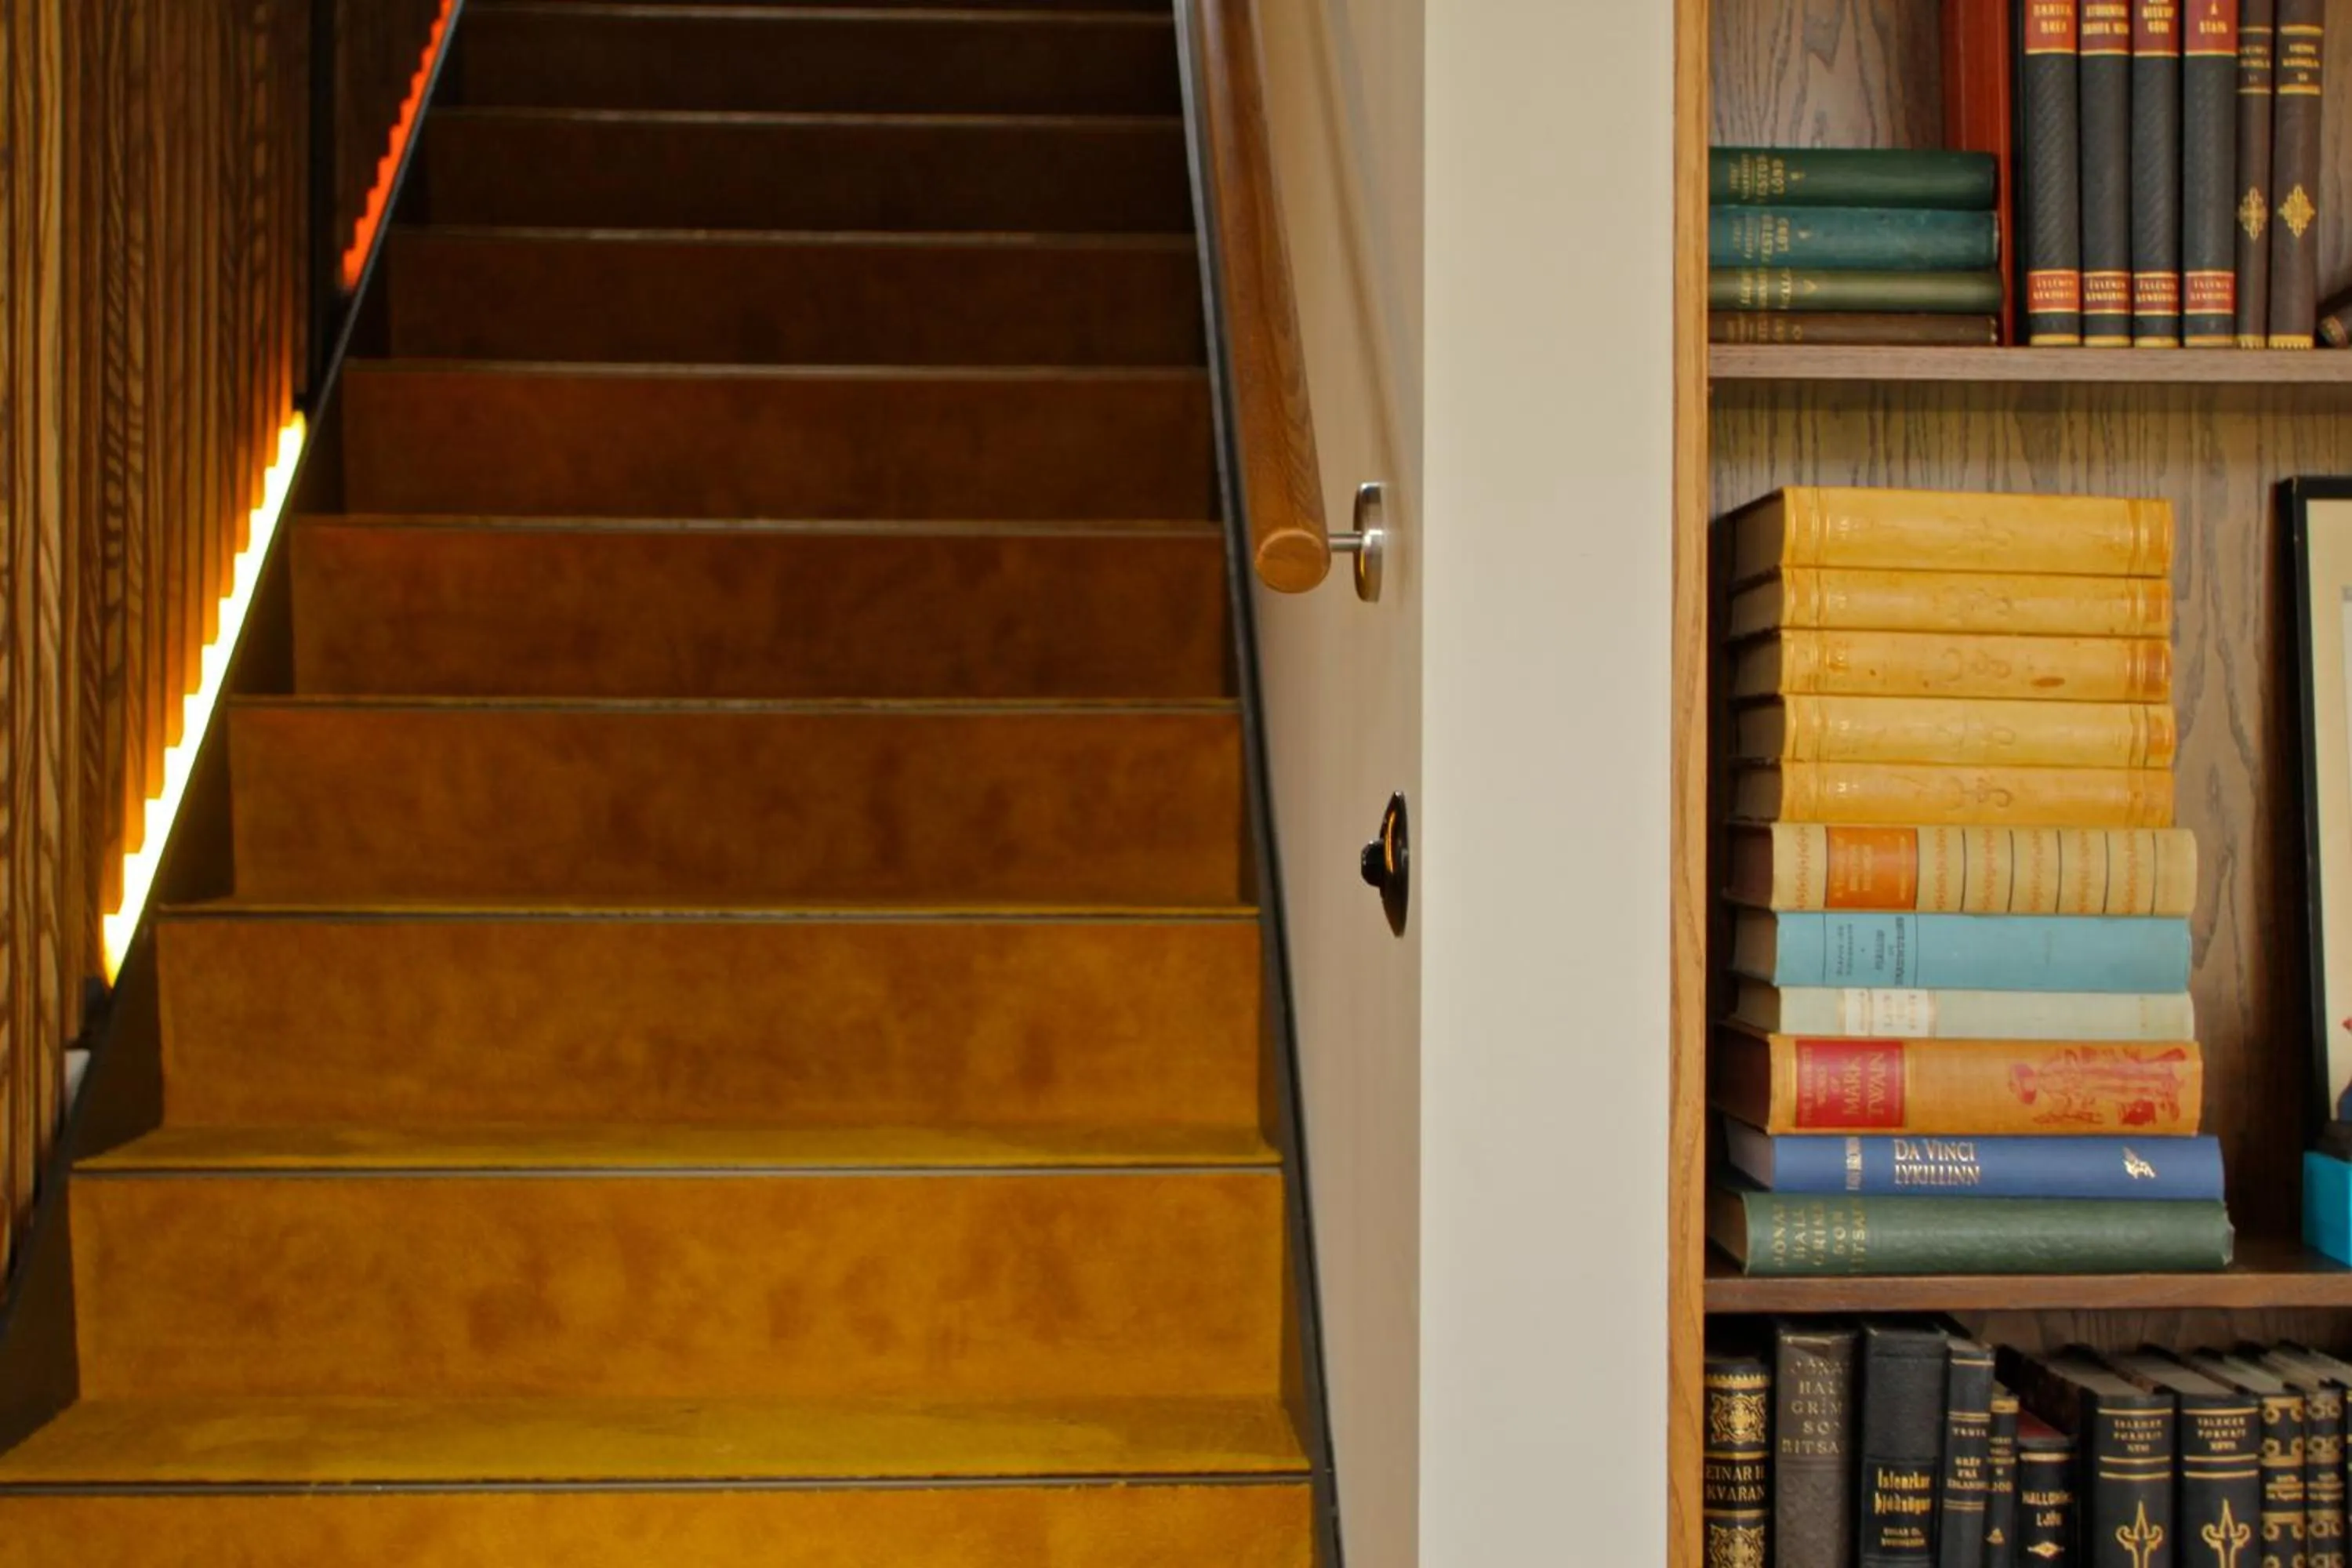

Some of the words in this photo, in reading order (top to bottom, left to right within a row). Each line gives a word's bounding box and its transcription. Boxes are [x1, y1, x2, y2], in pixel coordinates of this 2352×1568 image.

[1842, 1056, 1861, 1116] MARK
[1867, 1051, 1887, 1119] TWAIN
[1894, 1163, 1980, 1186] LYKILLINN
[1706, 1483, 1766, 1502] KVARAN
